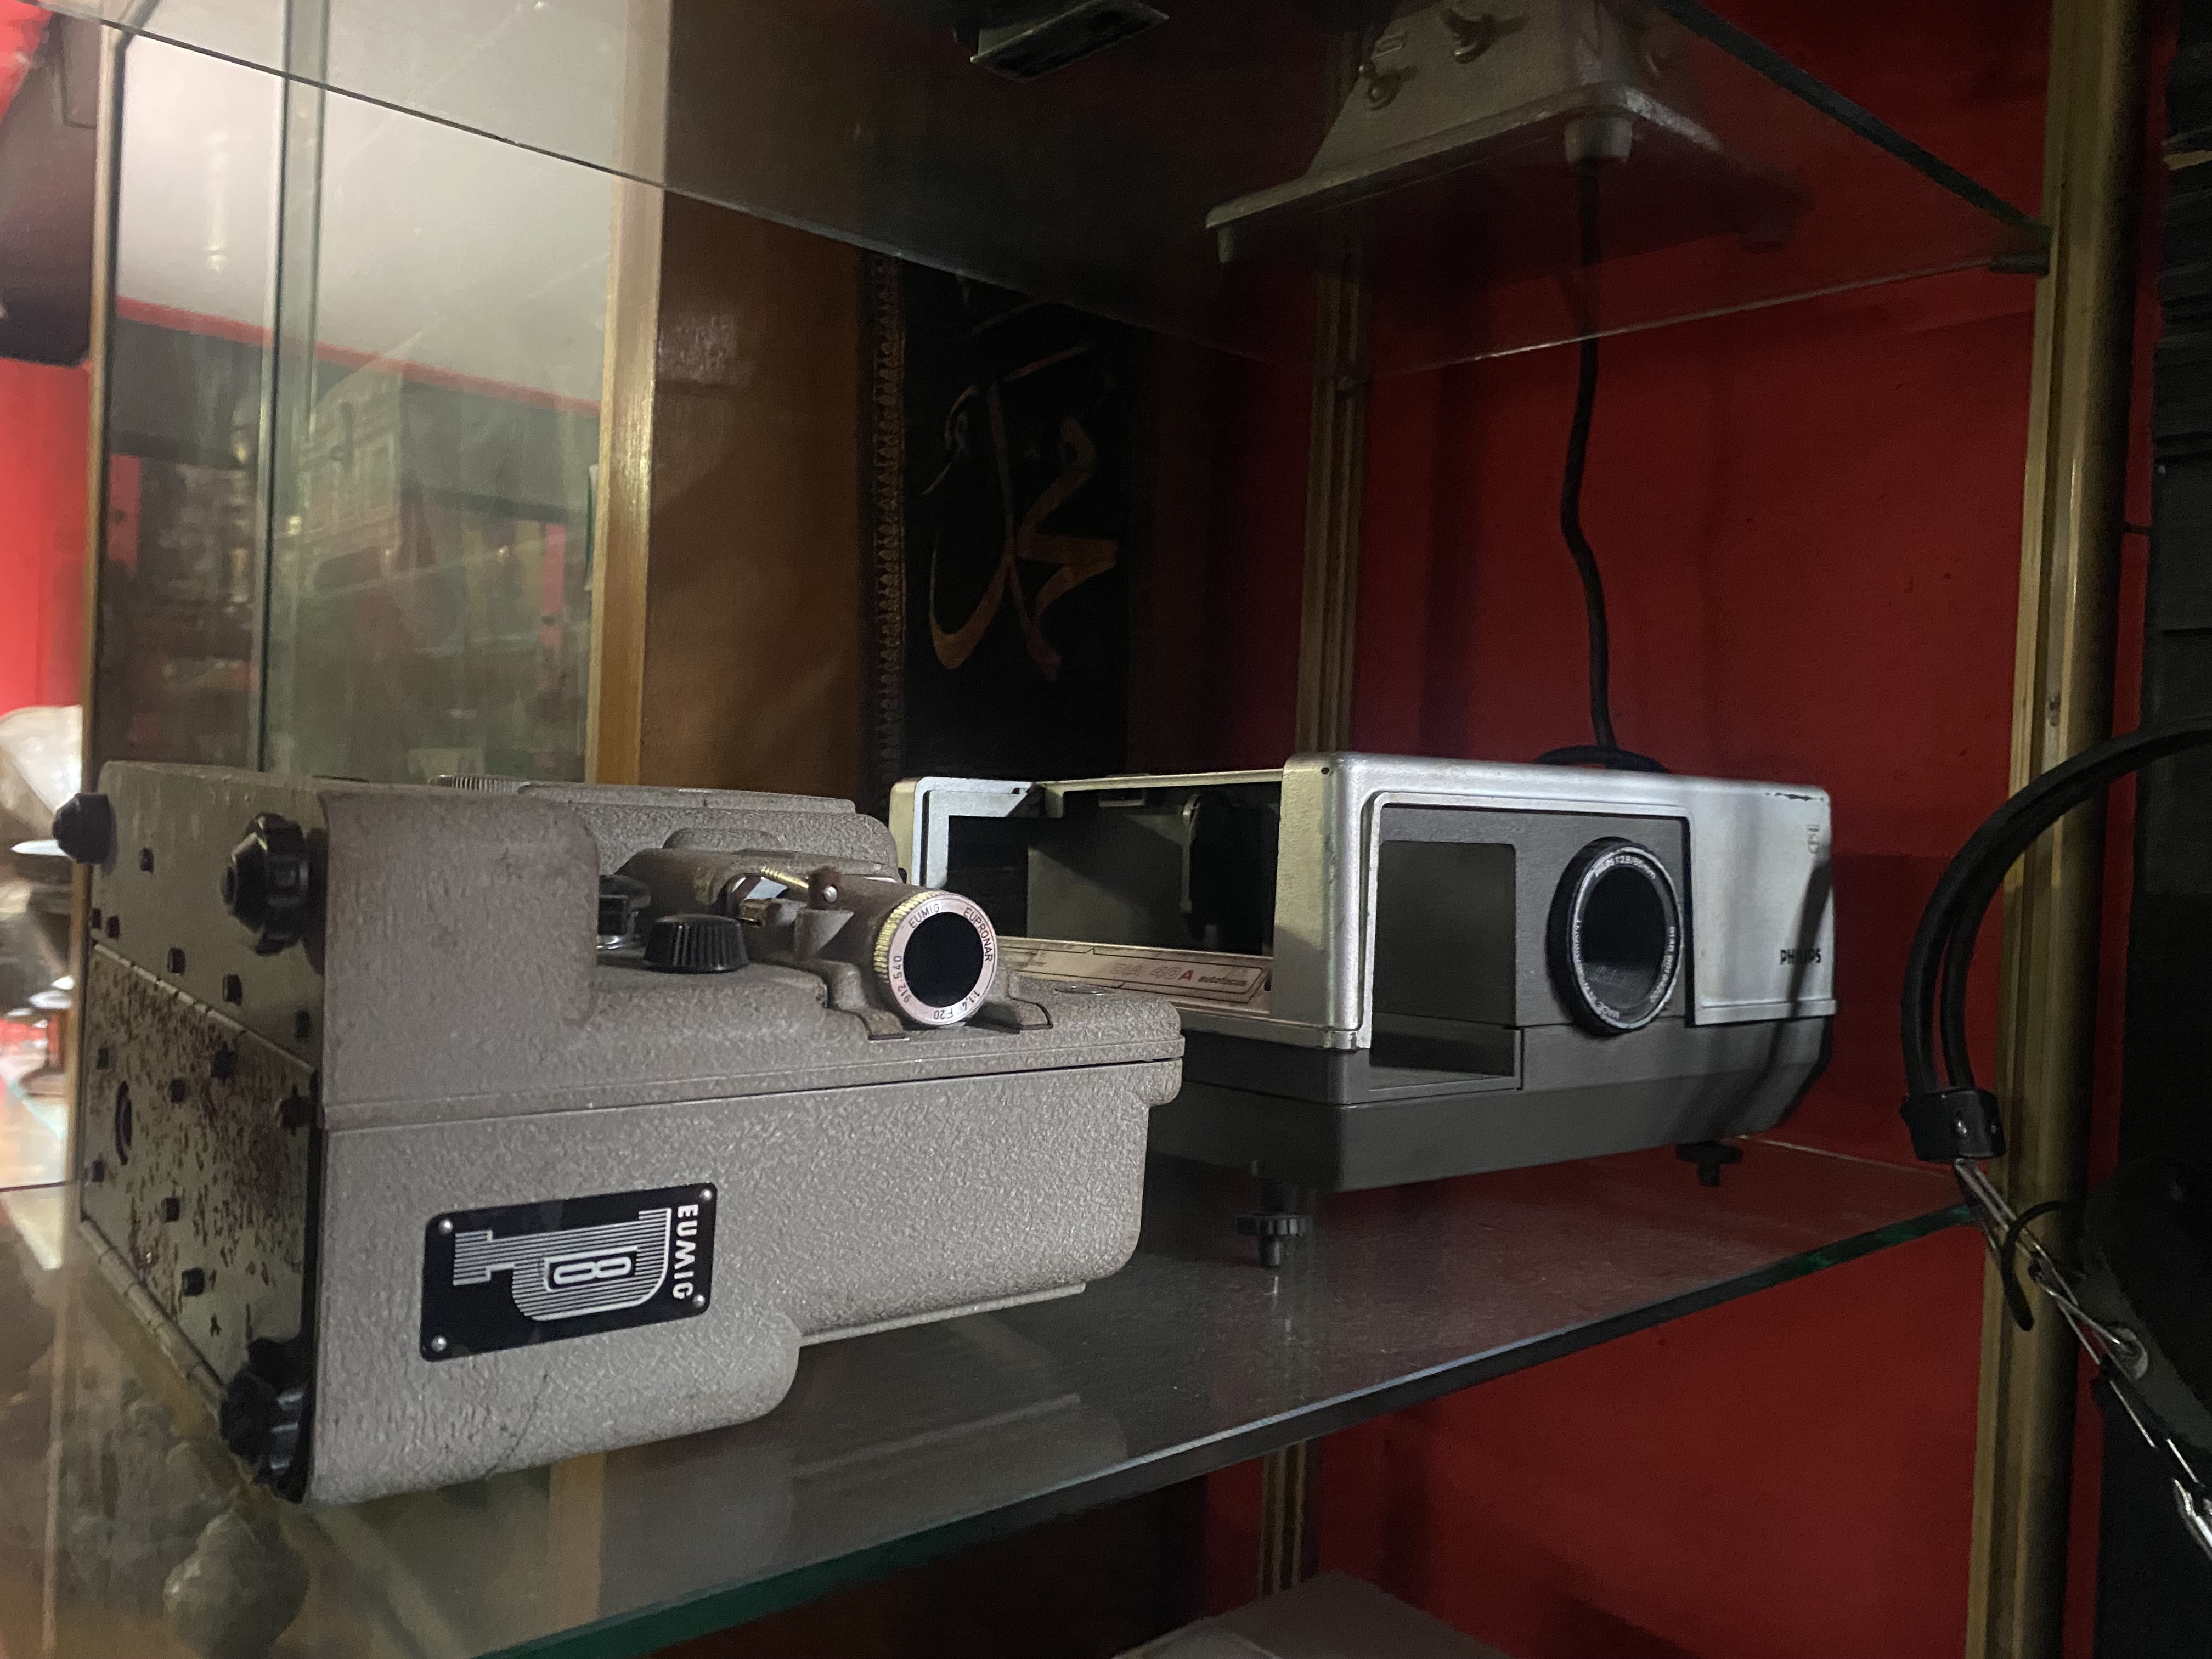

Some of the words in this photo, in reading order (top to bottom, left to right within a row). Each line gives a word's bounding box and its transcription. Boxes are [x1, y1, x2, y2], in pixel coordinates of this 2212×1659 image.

[909, 903, 940, 929] EUMIG
[963, 907, 993, 961] EUPRONAR
[893, 956, 911, 1003] 912.540
[1780, 947, 1821, 965] PHPS
[672, 1204, 699, 1301] EUMIG
